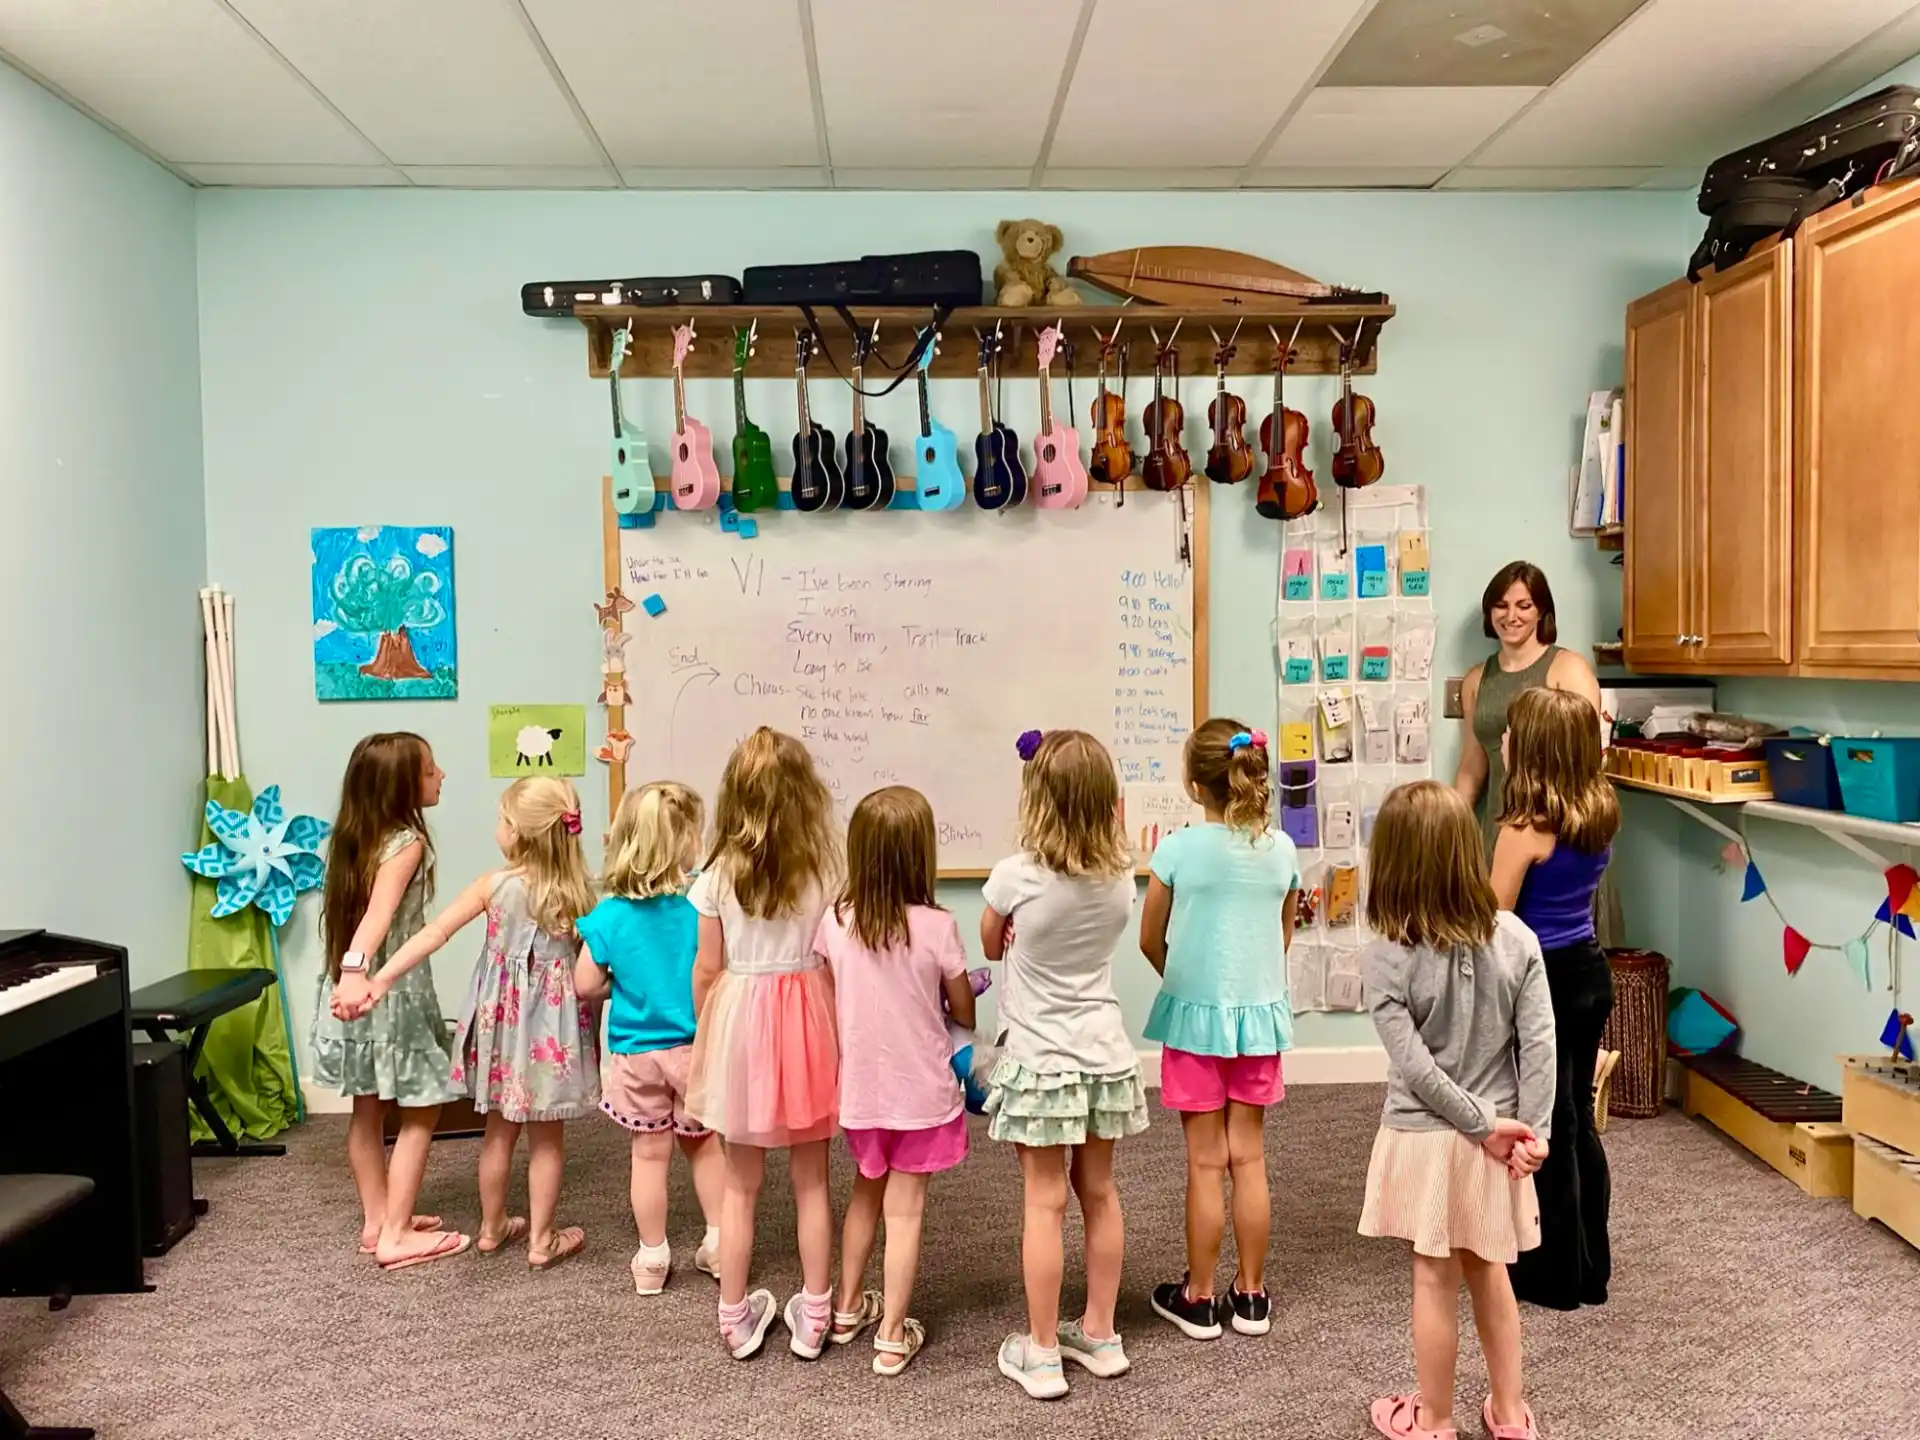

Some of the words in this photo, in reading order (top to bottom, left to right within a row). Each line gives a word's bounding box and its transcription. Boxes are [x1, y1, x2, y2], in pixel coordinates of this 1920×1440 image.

[797, 570, 831, 592] I've
[837, 571, 872, 589] been
[797, 597, 815, 615] I
[822, 603, 857, 618] wish
[786, 620, 833, 657] Every
[669, 646, 700, 667] End
[793, 648, 827, 684] Long
[832, 658, 848, 678] to
[935, 687, 951, 698] me
[821, 707, 841, 720] one
[881, 706, 903, 723] how
[911, 706, 929, 722] far
[822, 728, 840, 743] the
